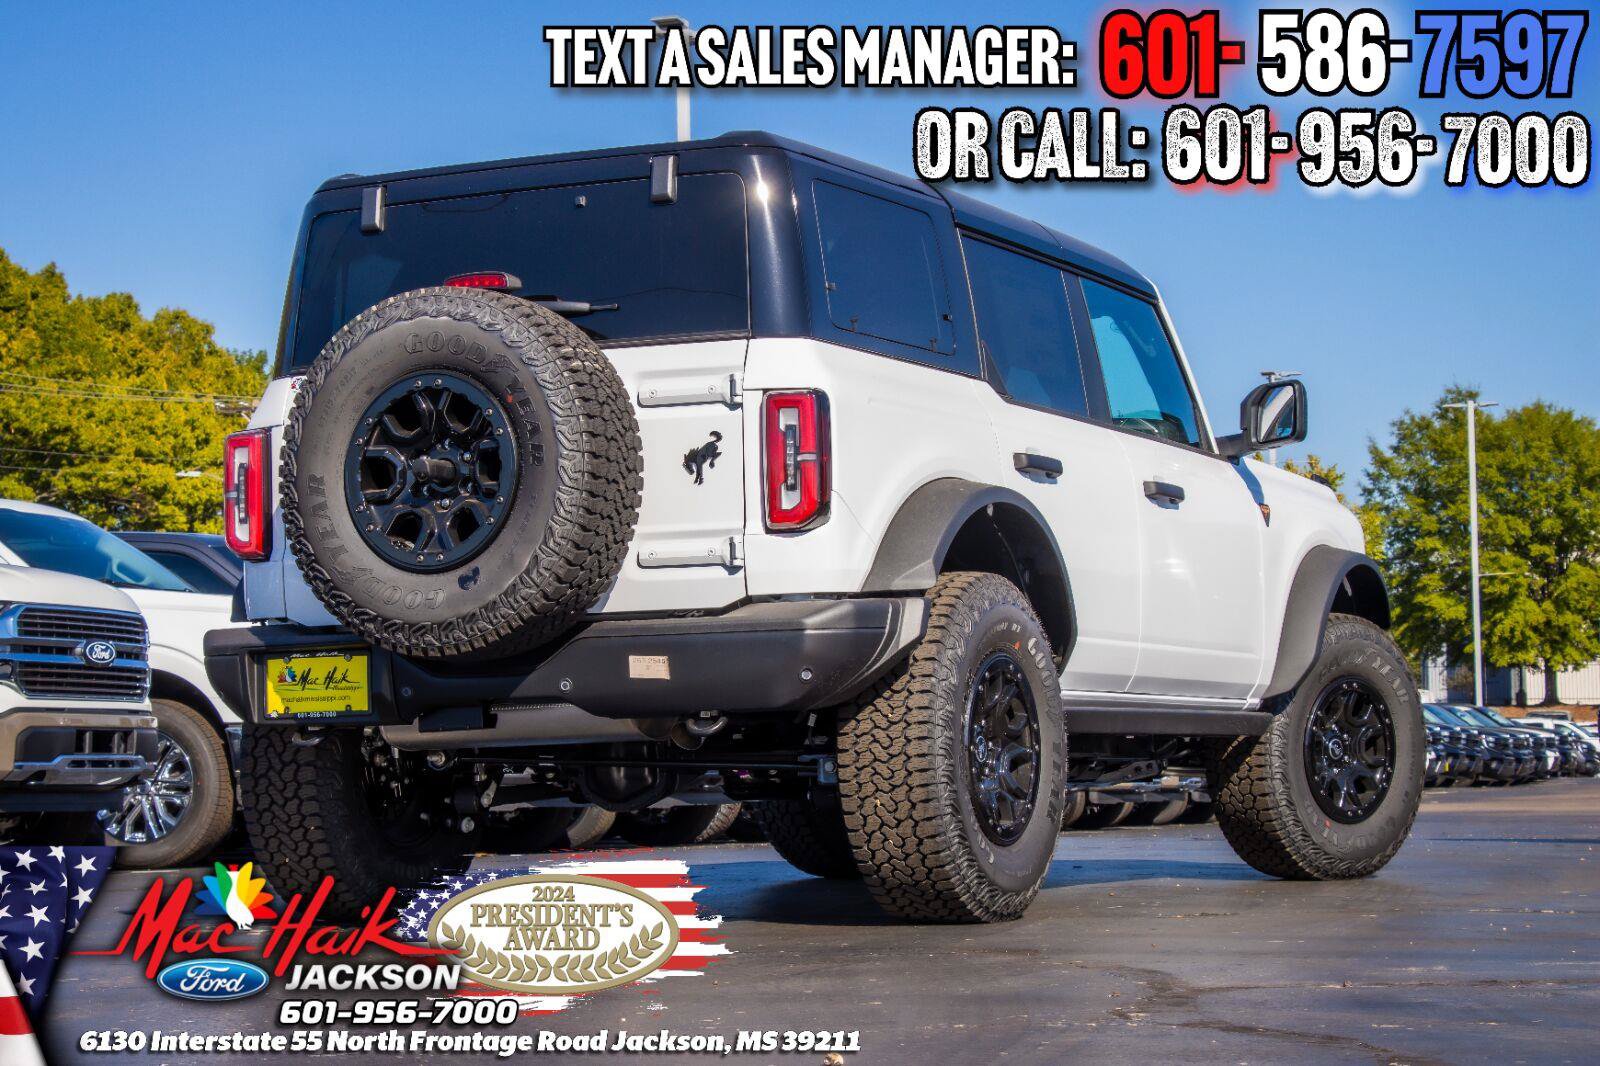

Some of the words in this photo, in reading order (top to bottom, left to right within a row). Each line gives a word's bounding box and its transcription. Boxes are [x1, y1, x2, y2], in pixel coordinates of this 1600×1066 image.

[91, 644, 111, 660] Ford
[297, 667, 320, 691] Mac
[323, 666, 359, 690] Haik
